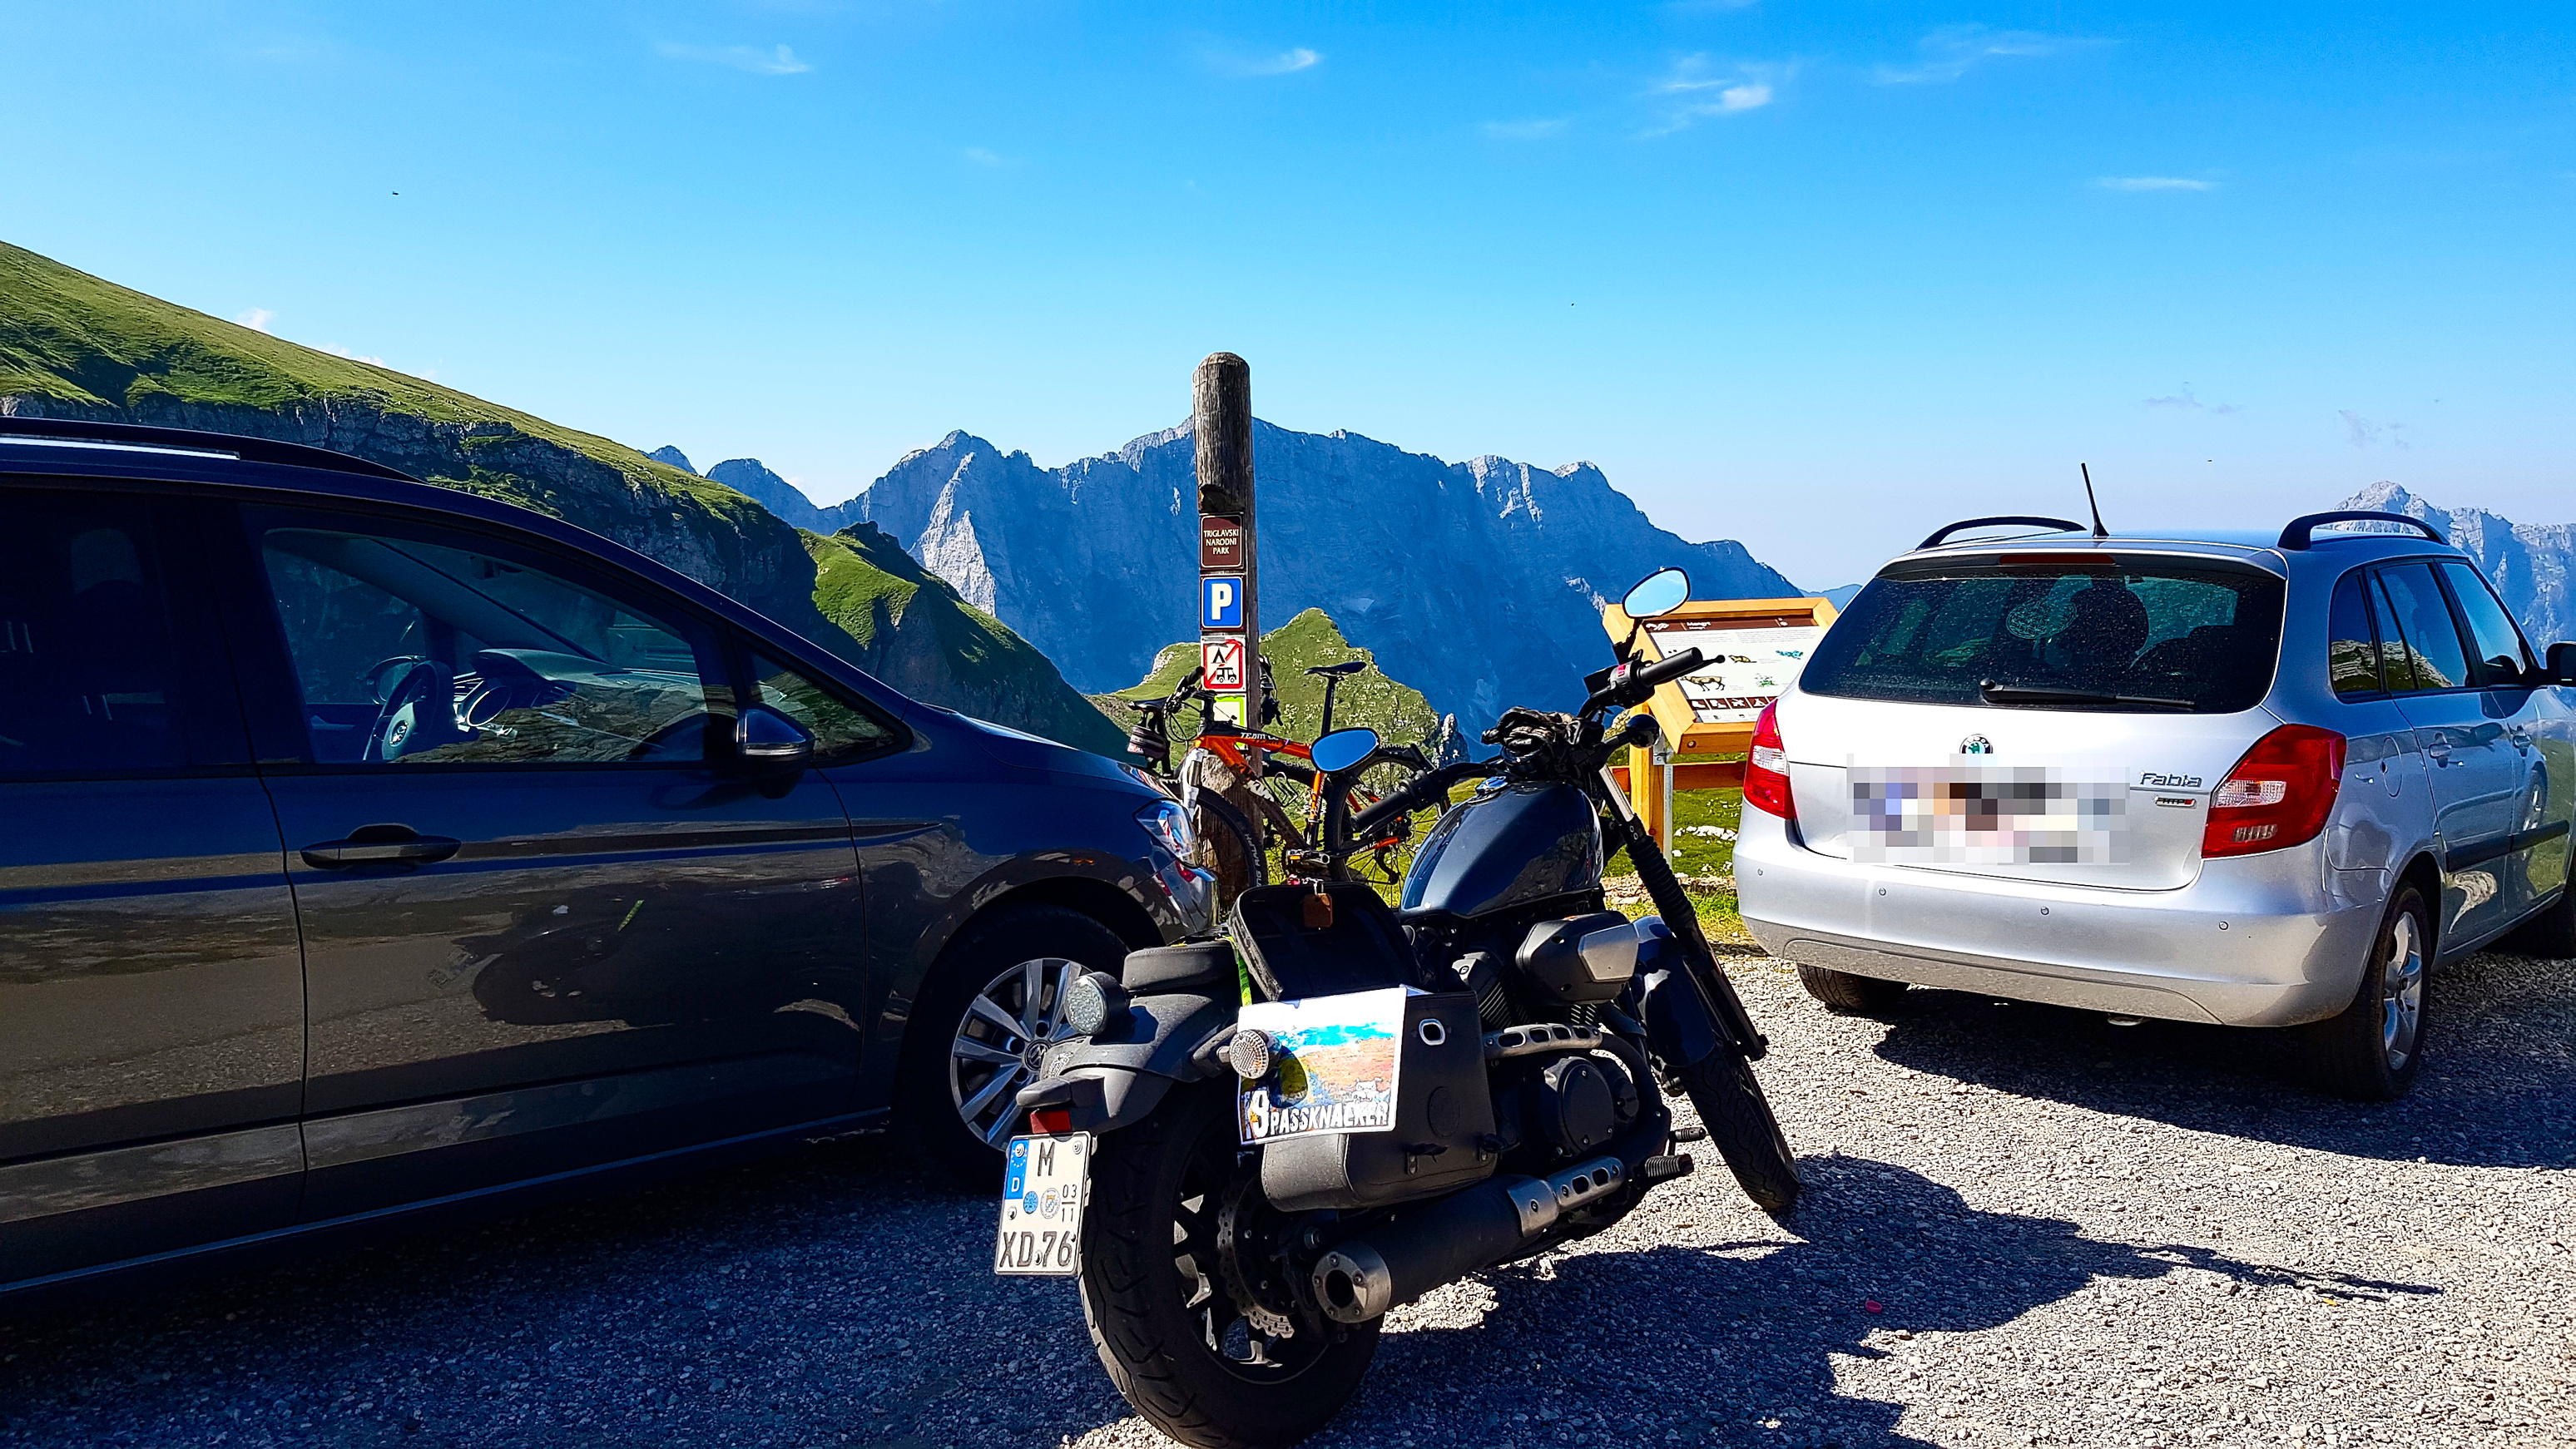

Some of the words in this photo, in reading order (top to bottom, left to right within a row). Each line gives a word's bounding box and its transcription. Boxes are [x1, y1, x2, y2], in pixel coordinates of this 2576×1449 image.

[1203, 528, 1239, 538] TRIGLAVSKI
[1206, 537, 1237, 546] NARODNI
[1212, 546, 1230, 555] PARK
[1211, 583, 1232, 621] P
[2139, 772, 2202, 789] Fabia
[1037, 1141, 1056, 1177] M
[1011, 1177, 1020, 1193] D
[1062, 1184, 1077, 1199] 03
[1061, 1207, 1074, 1223] 11
